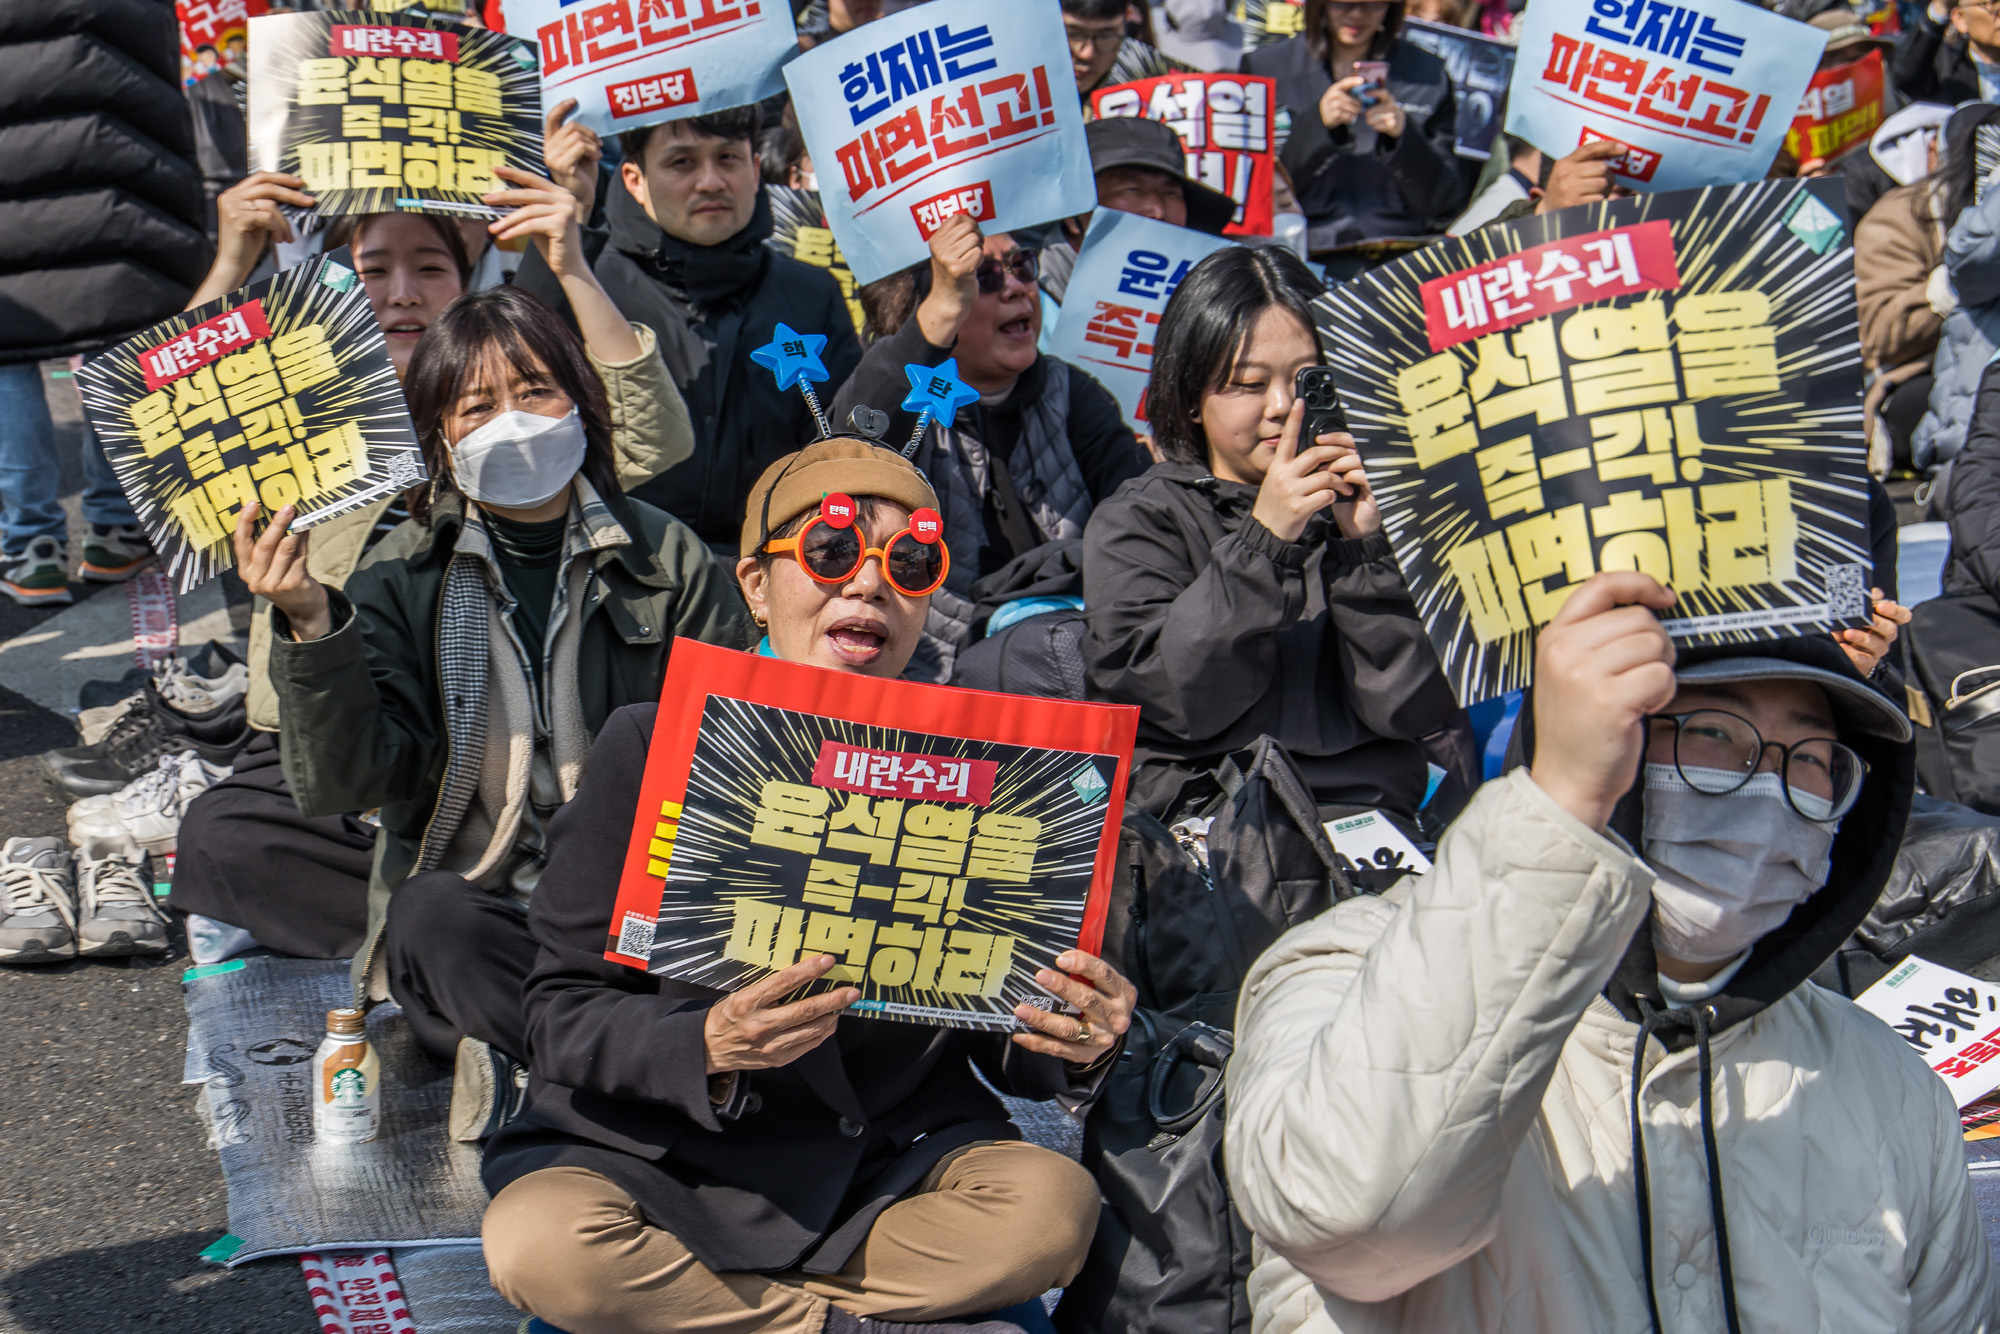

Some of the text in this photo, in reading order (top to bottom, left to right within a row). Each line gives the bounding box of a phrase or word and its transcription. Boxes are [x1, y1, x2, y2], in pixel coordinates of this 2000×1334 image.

[343, 28, 444, 56] 내란수괴
[537, 0, 761, 78] 파면선
[1585, 0, 1746, 75] 헌재는
[298, 56, 503, 116] 윤석열을
[613, 74, 685, 111] 진보당
[838, 24, 997, 126] 헌재는
[1542, 33, 1771, 145] 파면선고!
[299, 141, 506, 194] 파면하라
[835, 65, 1056, 202] 파면선고!
[916, 187, 984, 232] 진보당
[1440, 233, 1640, 329] 내란수괴
[149, 312, 253, 381] 내란수괴
[781, 340, 807, 358] 핵
[1399, 290, 1780, 470] 윤석열을
[130, 324, 340, 459] 윤석열을
[927, 376, 952, 399] 탄
[172, 421, 371, 553] 파면하라
[829, 505, 850, 516] 탄핵
[918, 521, 937, 532] 탄핵
[1449, 478, 1799, 644] 파면하라
[834, 751, 970, 797] 내란수괴
[751, 780, 1042, 883] 윤석열을
[724, 897, 1014, 997] 파면하라
[1808, 1225, 1886, 1246] GUESS
